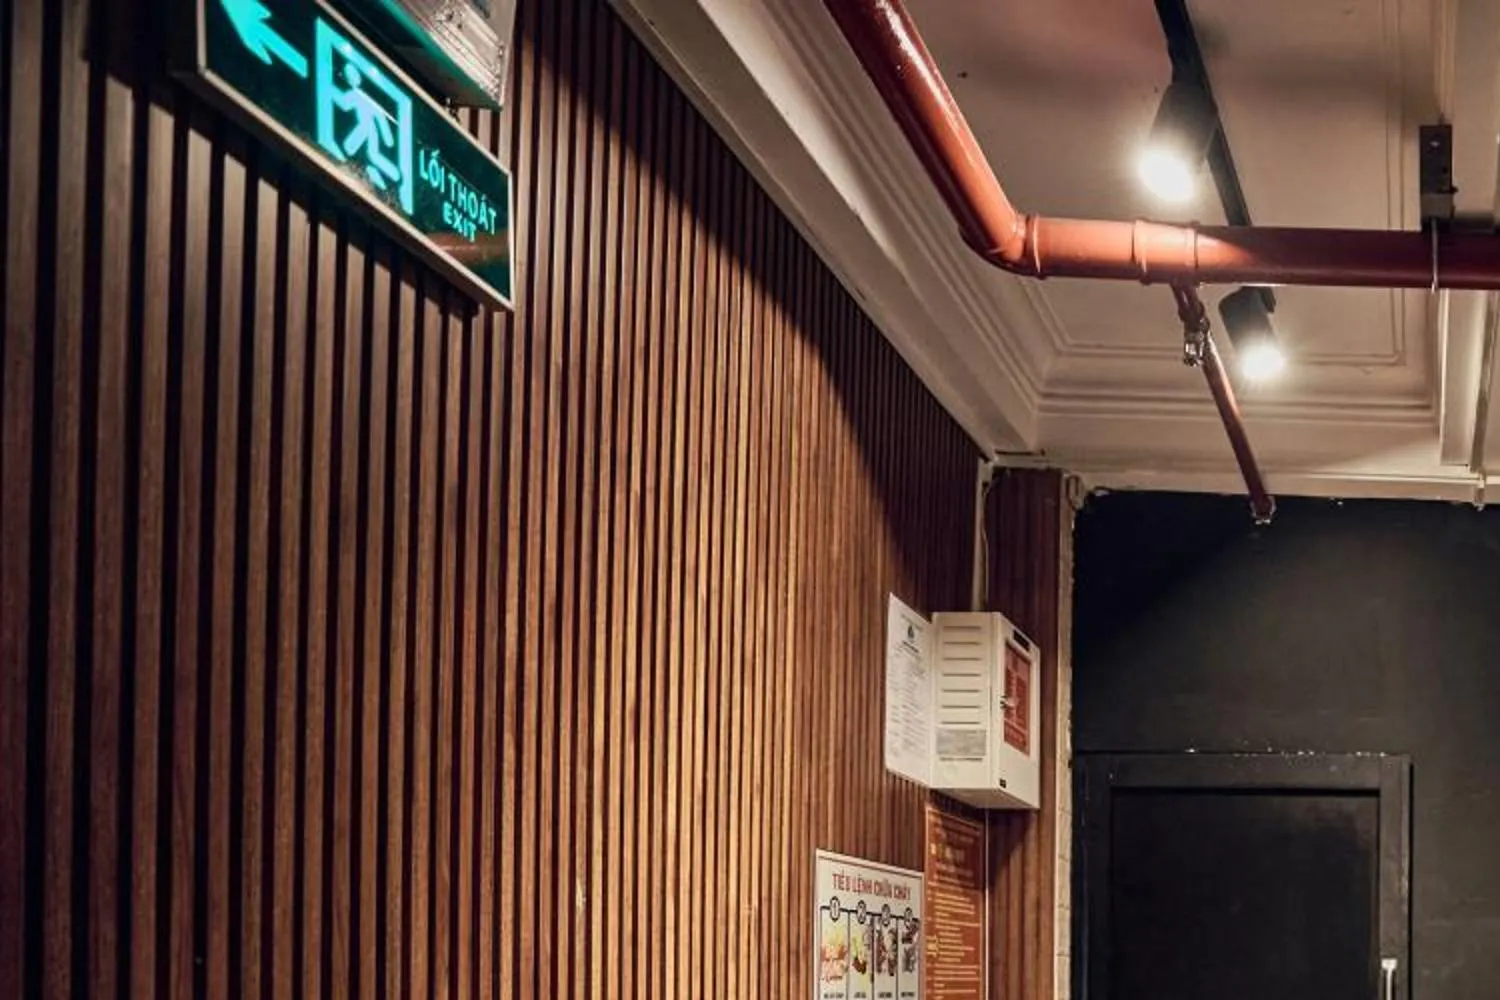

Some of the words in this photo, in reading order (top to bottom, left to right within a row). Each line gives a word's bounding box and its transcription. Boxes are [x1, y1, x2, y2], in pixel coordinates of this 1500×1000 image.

[419, 149, 445, 193] LỐI
[447, 172, 497, 236] THOÁT
[443, 201, 477, 243] EXIT
